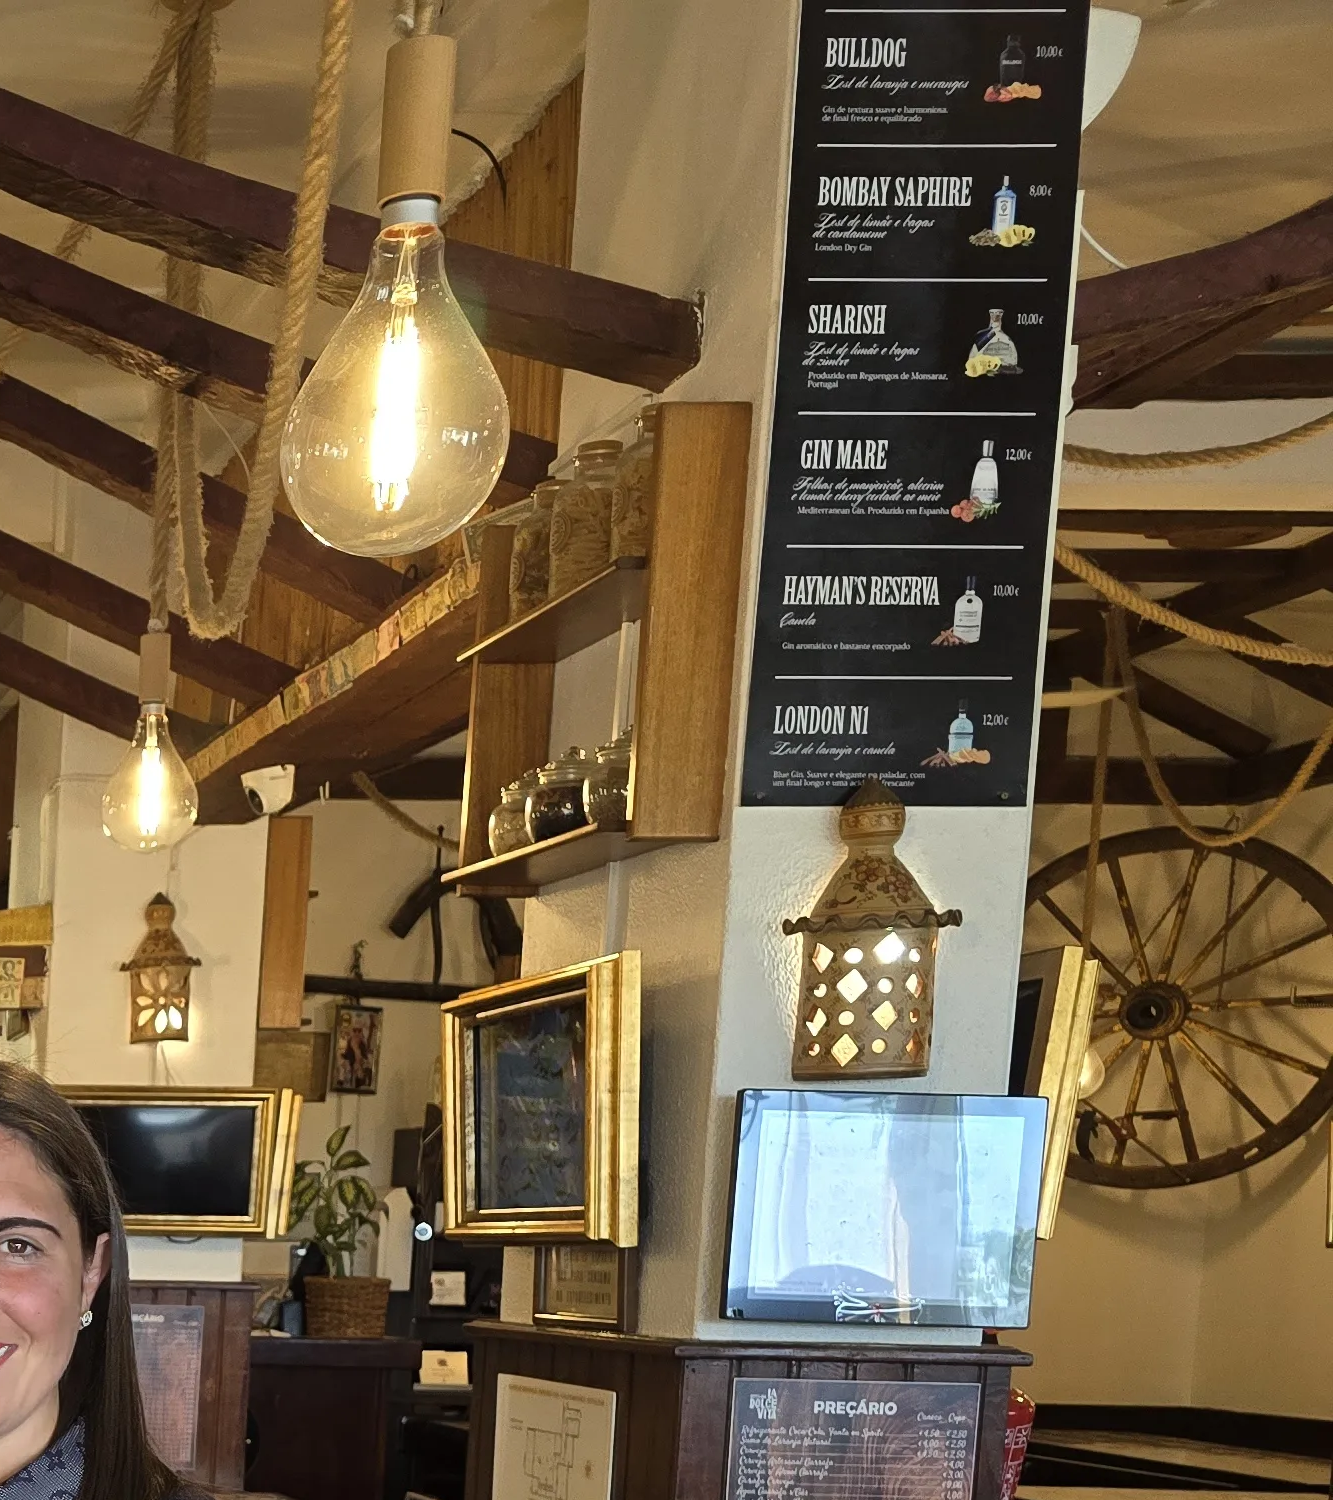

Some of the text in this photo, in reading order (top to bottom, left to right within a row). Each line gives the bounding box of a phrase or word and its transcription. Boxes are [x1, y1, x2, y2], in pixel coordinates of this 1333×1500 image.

[825, 38, 907, 67] BULLDOG
[821, 74, 856, 89] Zest
[855, 76, 868, 88] de
[870, 75, 907, 95] laranja
[918, 81, 969, 95] morangos
[822, 114, 831, 122] de
[851, 114, 873, 122] fresco
[880, 115, 922, 124] equilibrado
[818, 177, 891, 206] BOMBAY
[894, 177, 972, 206] SAPHIRE
[814, 213, 849, 228] Zest
[847, 214, 860, 227] de
[862, 213, 893, 227] limão
[903, 214, 935, 233] bagas
[812, 227, 887, 238] de cardamomo
[815, 243, 842, 251] London
[845, 244, 858, 253] Dry
[808, 305, 887, 334] SHARISH
[804, 341, 920, 361] Zest de limão e bagas
[802, 355, 849, 366] de zimbro
[807, 380, 838, 390] Portugal
[859, 372, 899, 381] Reguengos
[900, 372, 909, 380] de
[801, 440, 833, 469] GIN
[835, 440, 888, 469] MARE
[835, 478, 848, 490] de
[907, 477, 944, 490] alecrim
[799, 490, 832, 500] tomate
[834, 489, 868, 507] cherry
[917, 492, 941, 501] meio
[797, 506, 850, 514] Mediterranean
[919, 507, 949, 516] Espanha
[783, 576, 867, 605] HAYMAN'S
[869, 576, 940, 605] RESERVA
[780, 612, 816, 628] Canela
[796, 642, 832, 650] aromático
[840, 642, 870, 650] bastante
[872, 643, 910, 651] encorpado
[773, 706, 846, 734] LONDON
[849, 706, 869, 734] N1
[769, 741, 802, 755] Zest
[801, 743, 814, 754] de
[816, 742, 852, 760] laranja
[863, 742, 896, 754] canela
[804, 779, 824, 788] longo
[836, 771, 866, 780] elegante
[814, 1399, 897, 1417] PREÇÁRIO
